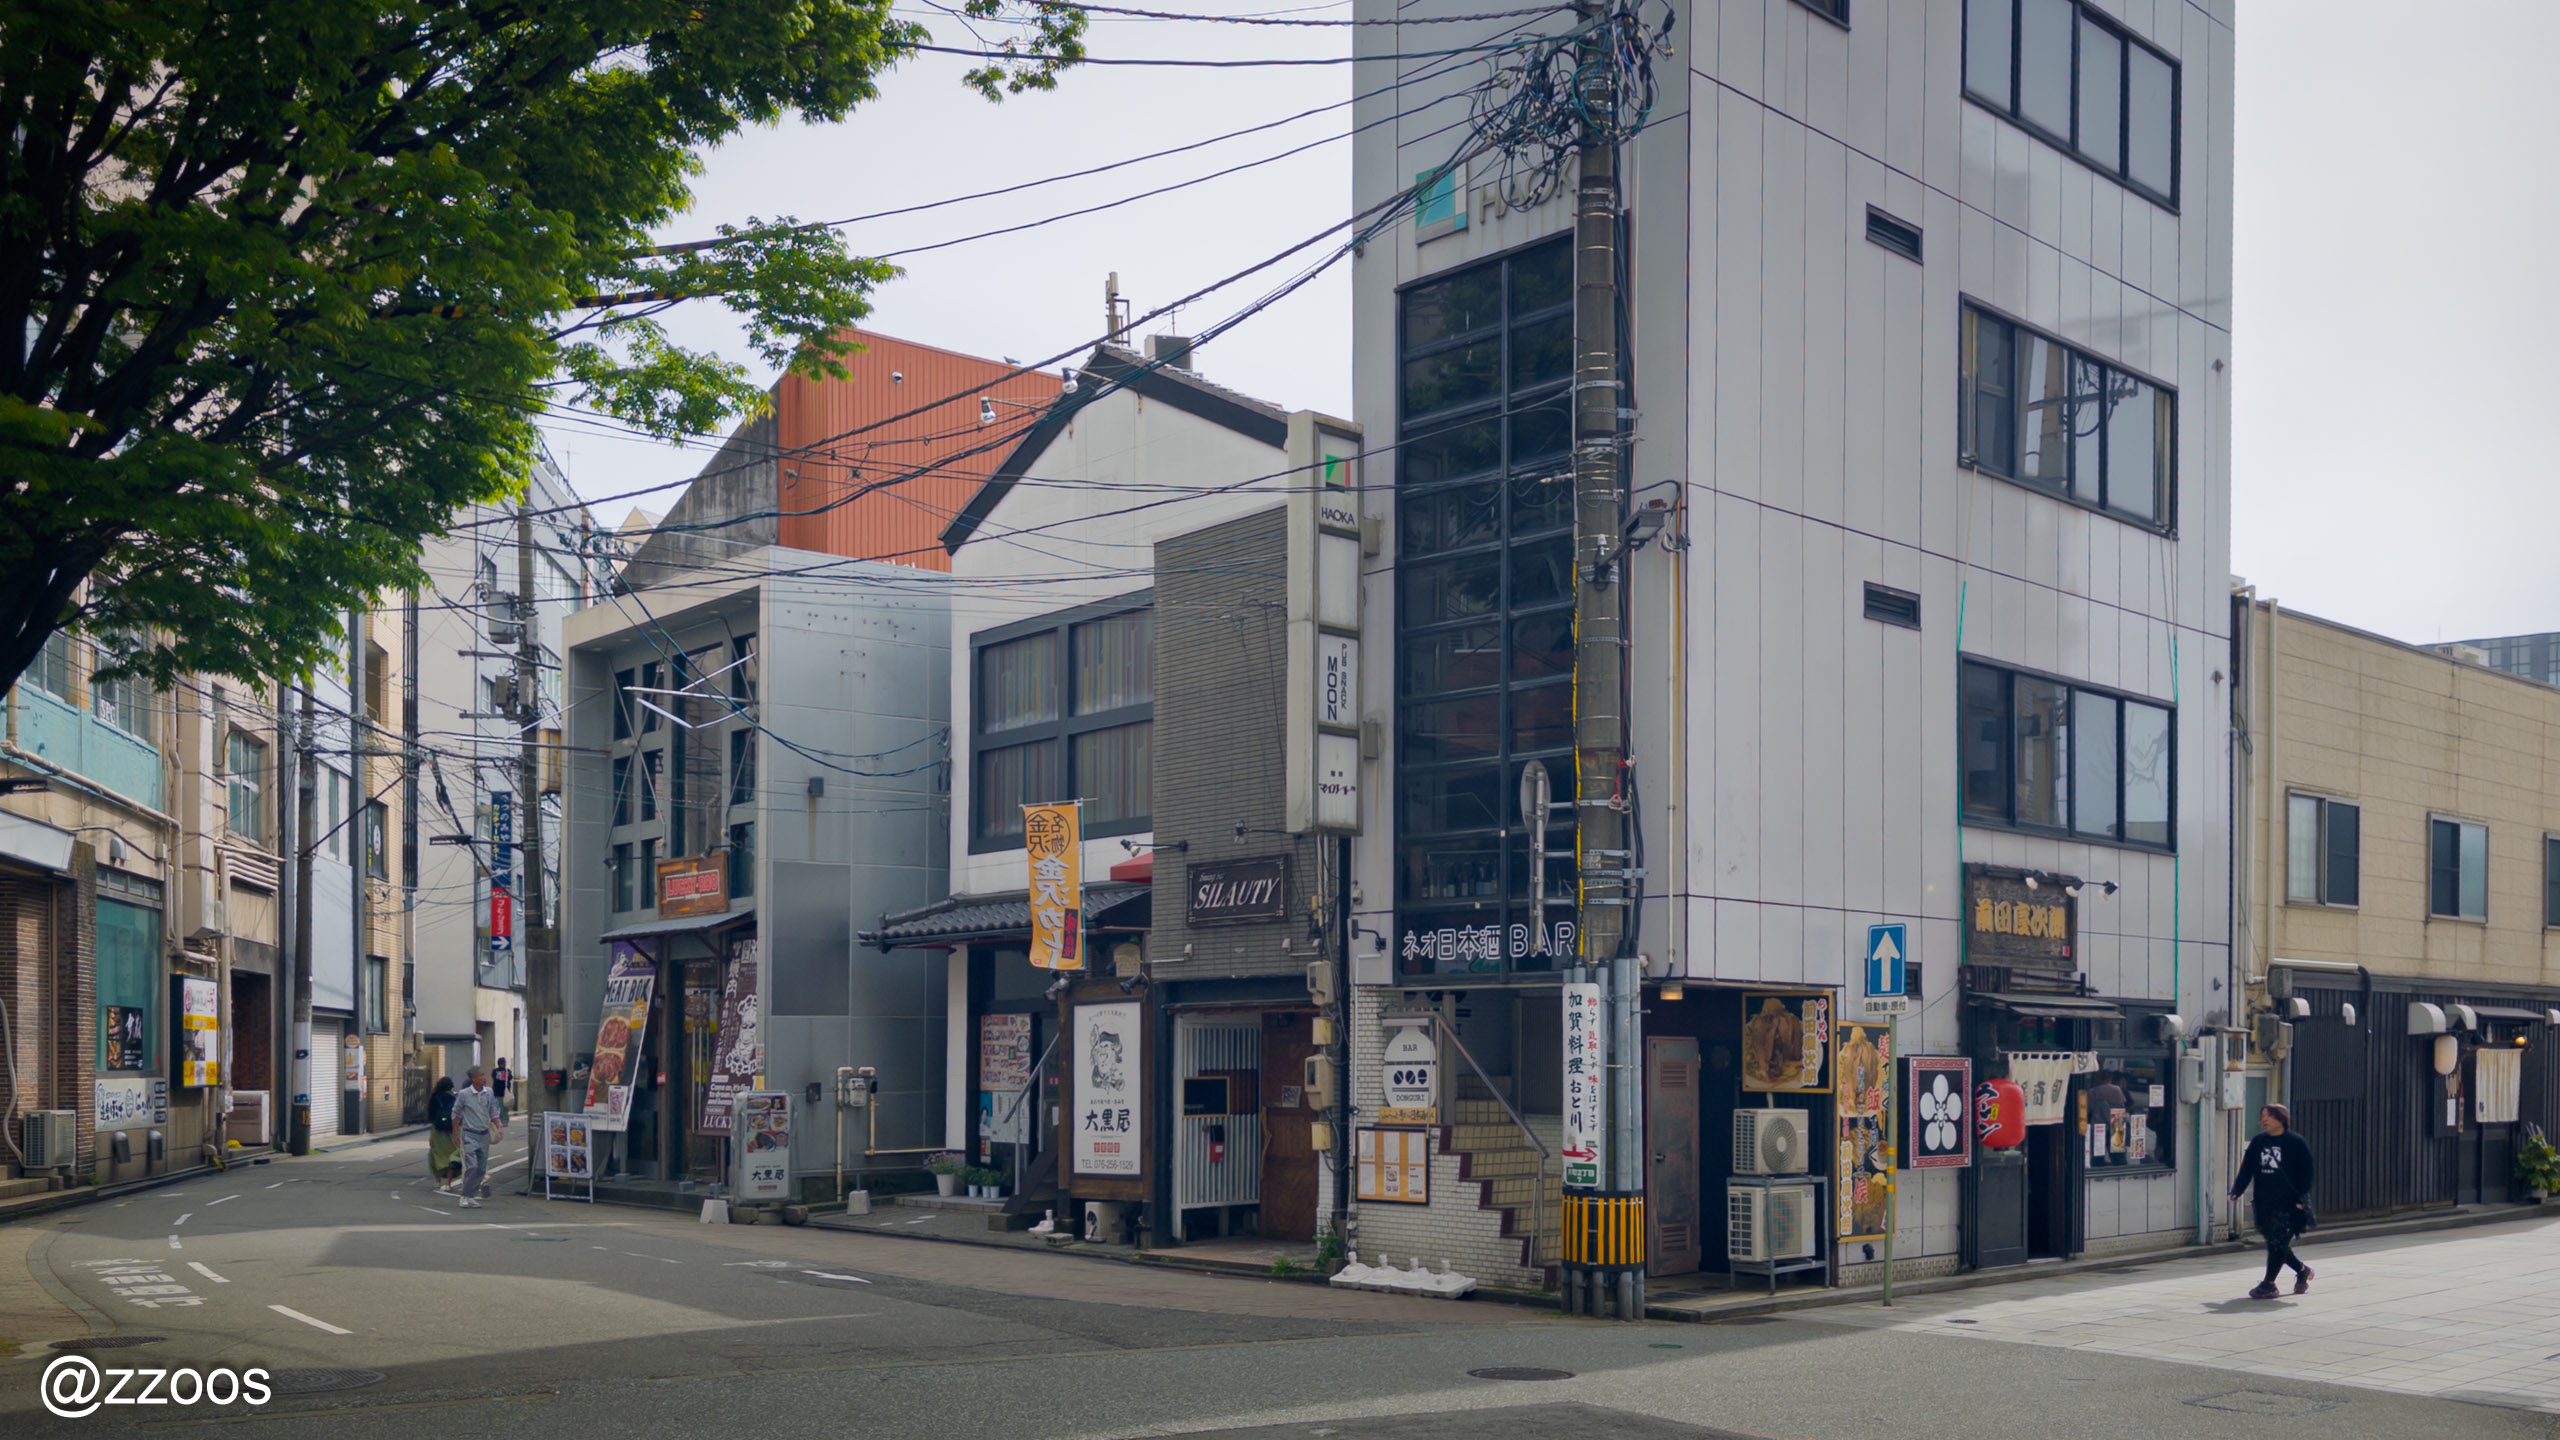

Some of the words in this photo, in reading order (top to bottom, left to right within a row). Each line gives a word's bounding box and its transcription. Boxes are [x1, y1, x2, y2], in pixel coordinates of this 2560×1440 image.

[1320, 506, 1356, 526] HAOKA
[1327, 655, 1338, 721] MOON
[1193, 877, 1281, 909] SILAUTY
[1402, 924, 1501, 961] ネオ日本酒
[1402, 1043, 1418, 1052] BAR
[1396, 1094, 1425, 1102] DONGURI
[1085, 1109, 1131, 1133] 大黒屋
[1081, 1159, 1093, 1169] TEL
